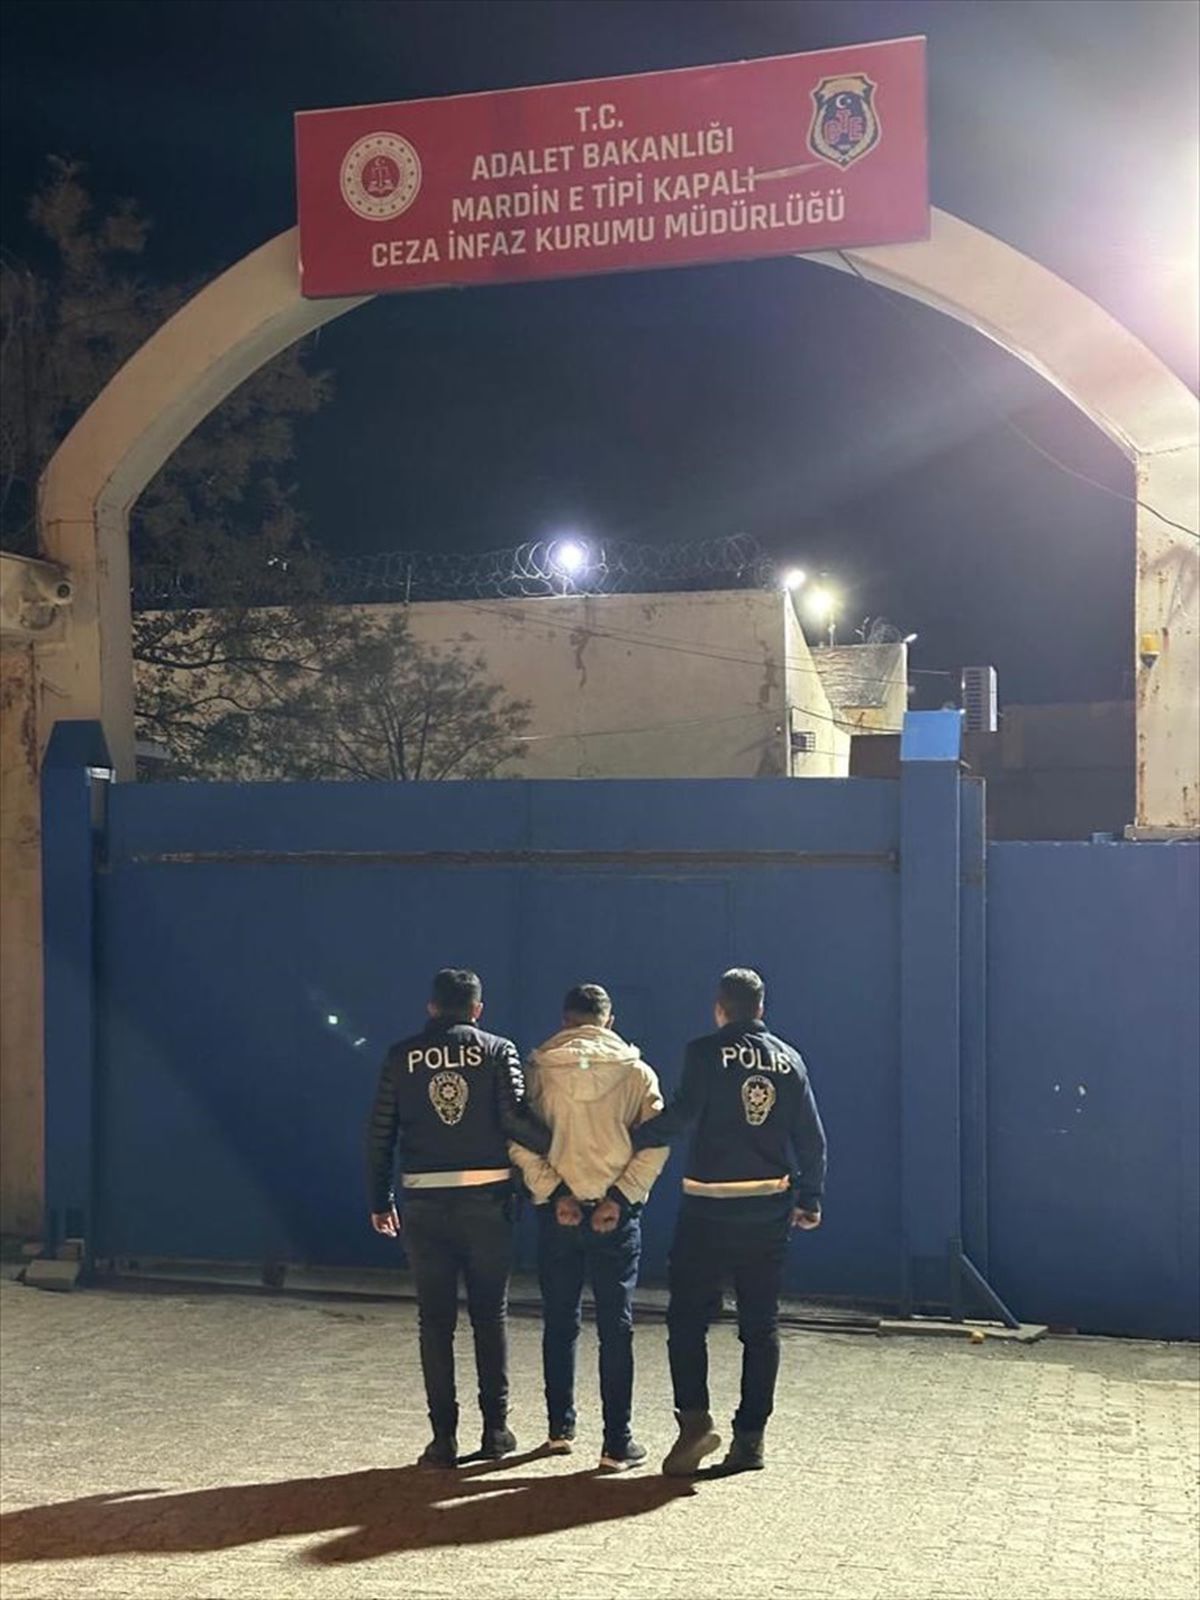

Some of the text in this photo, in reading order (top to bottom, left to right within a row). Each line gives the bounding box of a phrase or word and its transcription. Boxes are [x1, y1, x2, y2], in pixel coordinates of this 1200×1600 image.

[575, 104, 624, 131] T.C.
[473, 122, 734, 180] ADALET BAKANLIĞI
[453, 166, 755, 223] MARDİN E TİPİ KAPALI
[371, 189, 845, 268] CEZA İNFAZ KURUMU MÜDÜRLÜĞÜ
